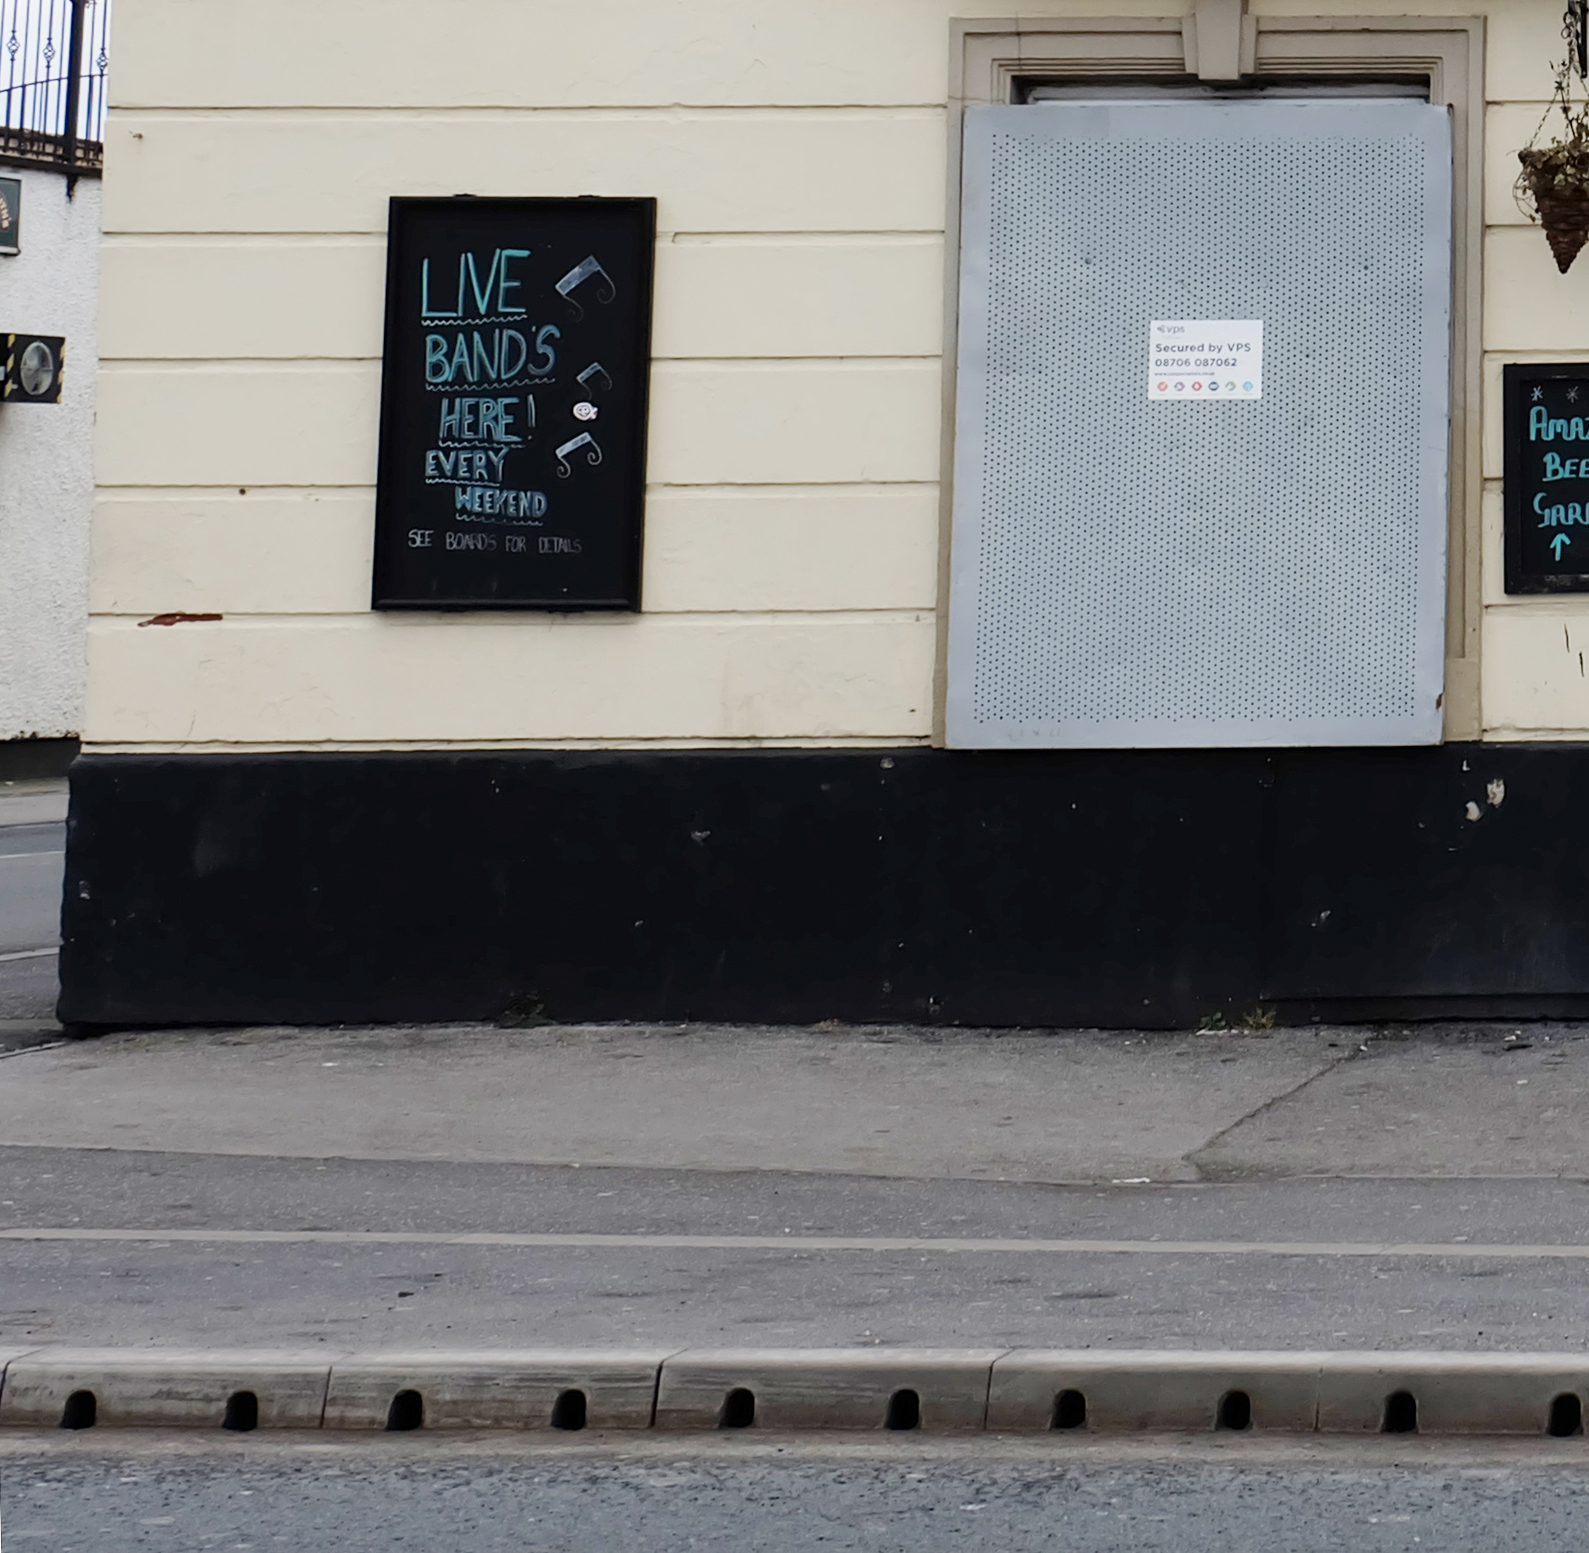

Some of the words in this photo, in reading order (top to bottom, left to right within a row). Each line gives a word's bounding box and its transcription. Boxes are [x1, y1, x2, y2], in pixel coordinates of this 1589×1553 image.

[421, 248, 531, 317] LIVE
[425, 324, 561, 383] BAND'S
[1155, 343, 1204, 352] Secured
[1208, 342, 1223, 353] by
[1227, 342, 1251, 352] VPS
[1155, 358, 1191, 367] 08706
[1194, 358, 1237, 367] 087062
[425, 447, 509, 480] EVERY
[455, 486, 548, 518] WEEKEND
[408, 529, 434, 547] SEE
[445, 531, 498, 550] BOARDS
[505, 536, 527, 552] FOR
[538, 537, 582, 554] DETAILS
